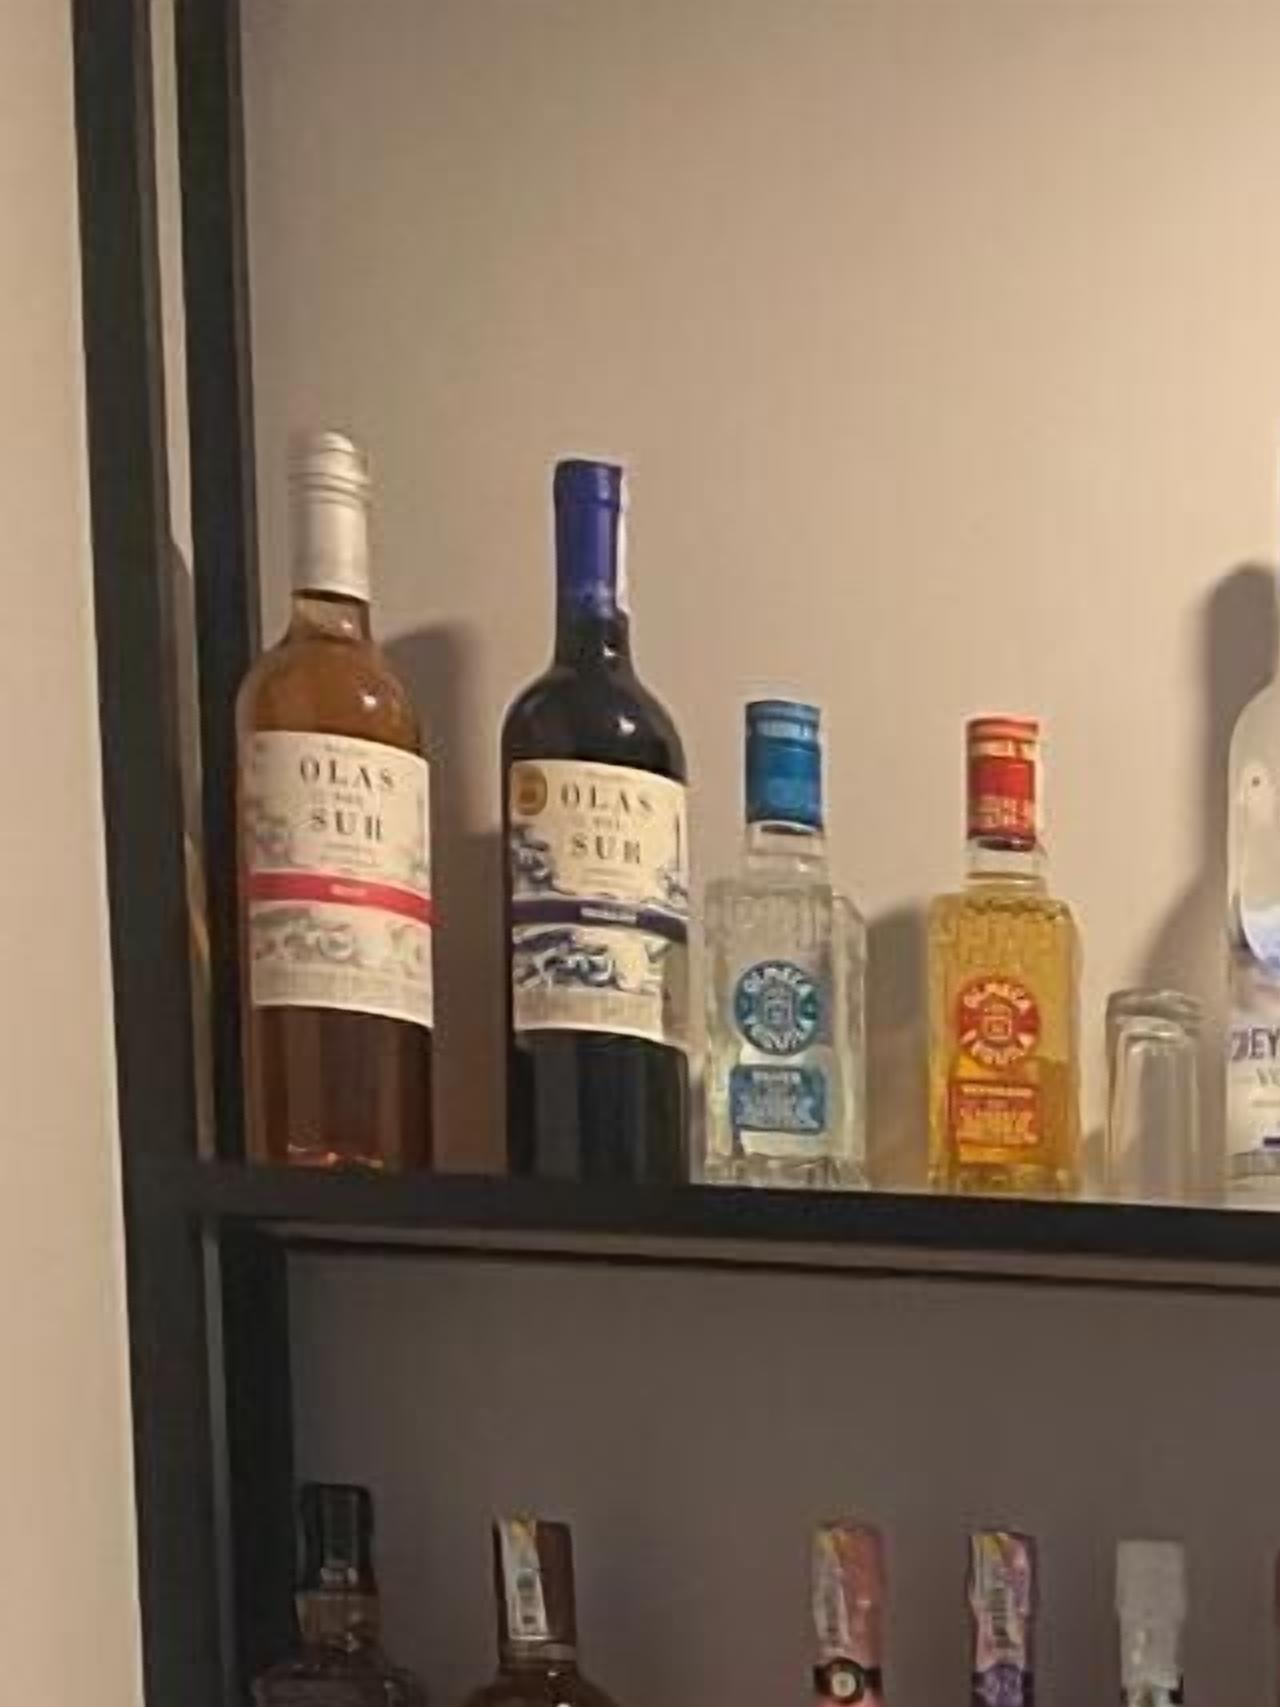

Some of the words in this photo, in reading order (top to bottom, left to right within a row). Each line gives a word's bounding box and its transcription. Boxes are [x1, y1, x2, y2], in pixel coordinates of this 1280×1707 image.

[300, 757, 395, 793] OLAS
[561, 783, 653, 813] OLAS
[571, 833, 641, 865] SUR
